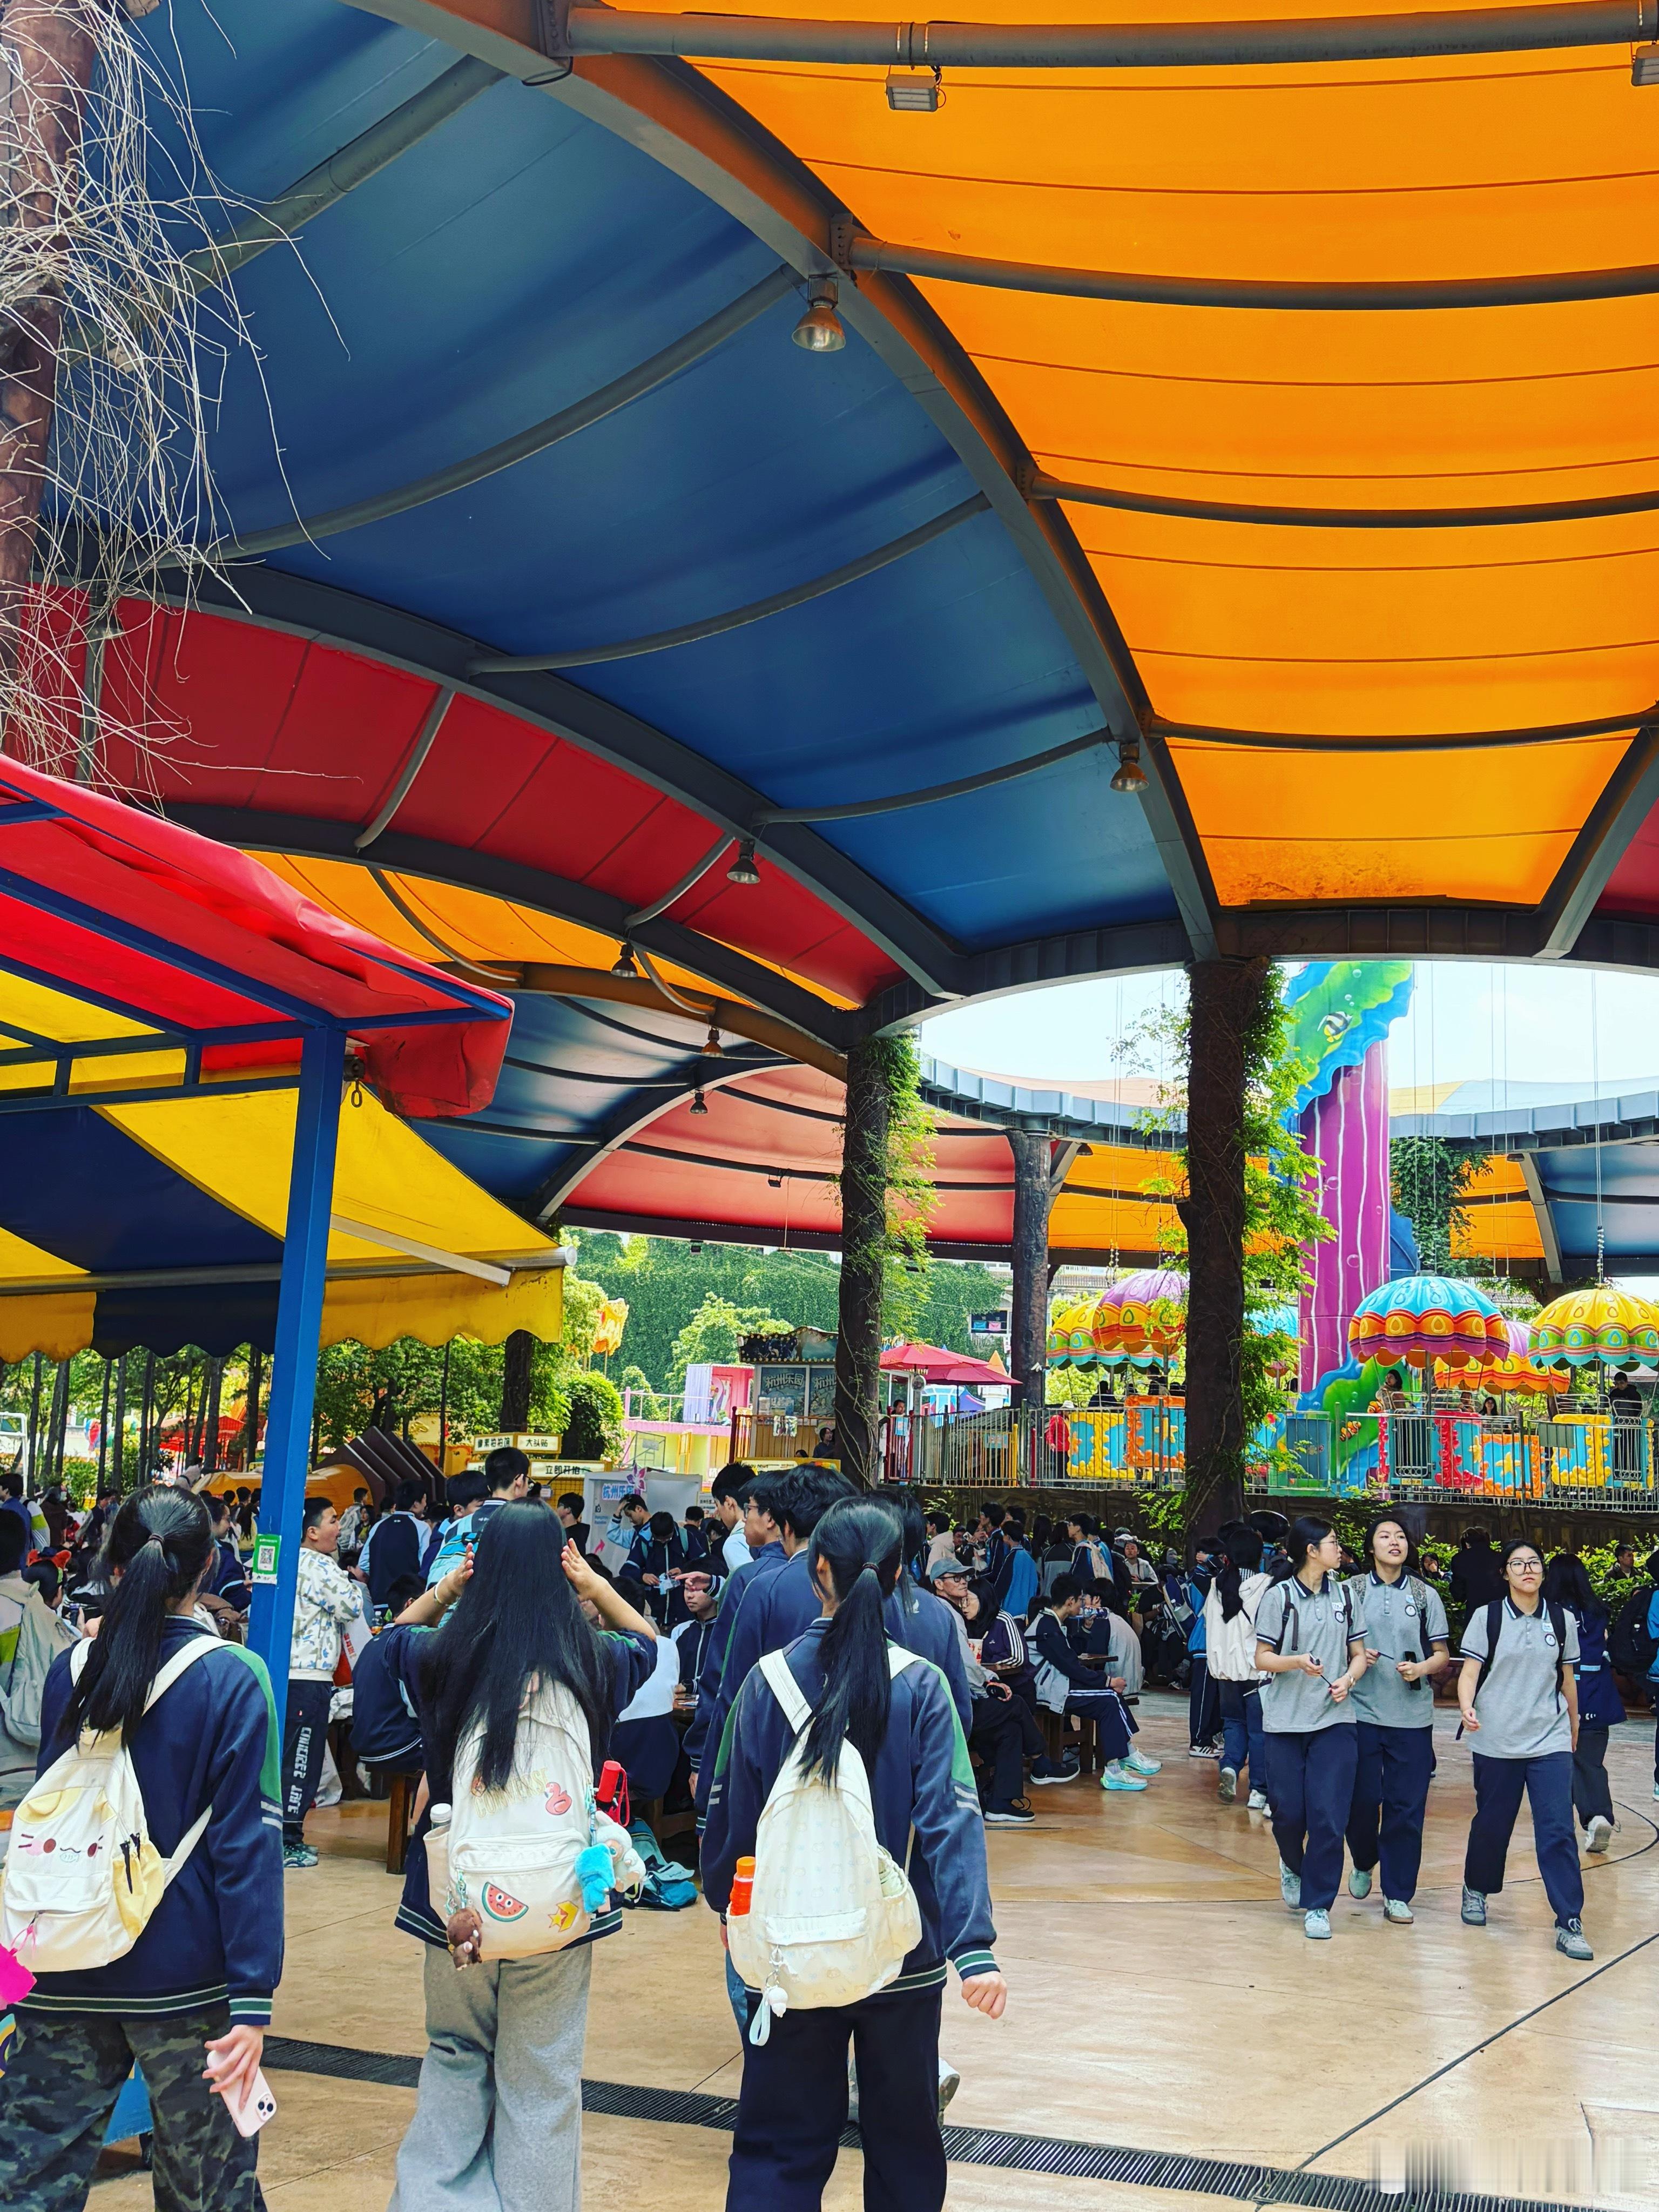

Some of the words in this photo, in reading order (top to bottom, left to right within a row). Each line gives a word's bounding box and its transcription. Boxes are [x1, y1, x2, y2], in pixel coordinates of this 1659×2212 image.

[765, 1373, 804, 1388] 杭州乐园
[526, 1439, 548, 1447] 大头贴
[545, 1465, 580, 1475] 立即开拍
